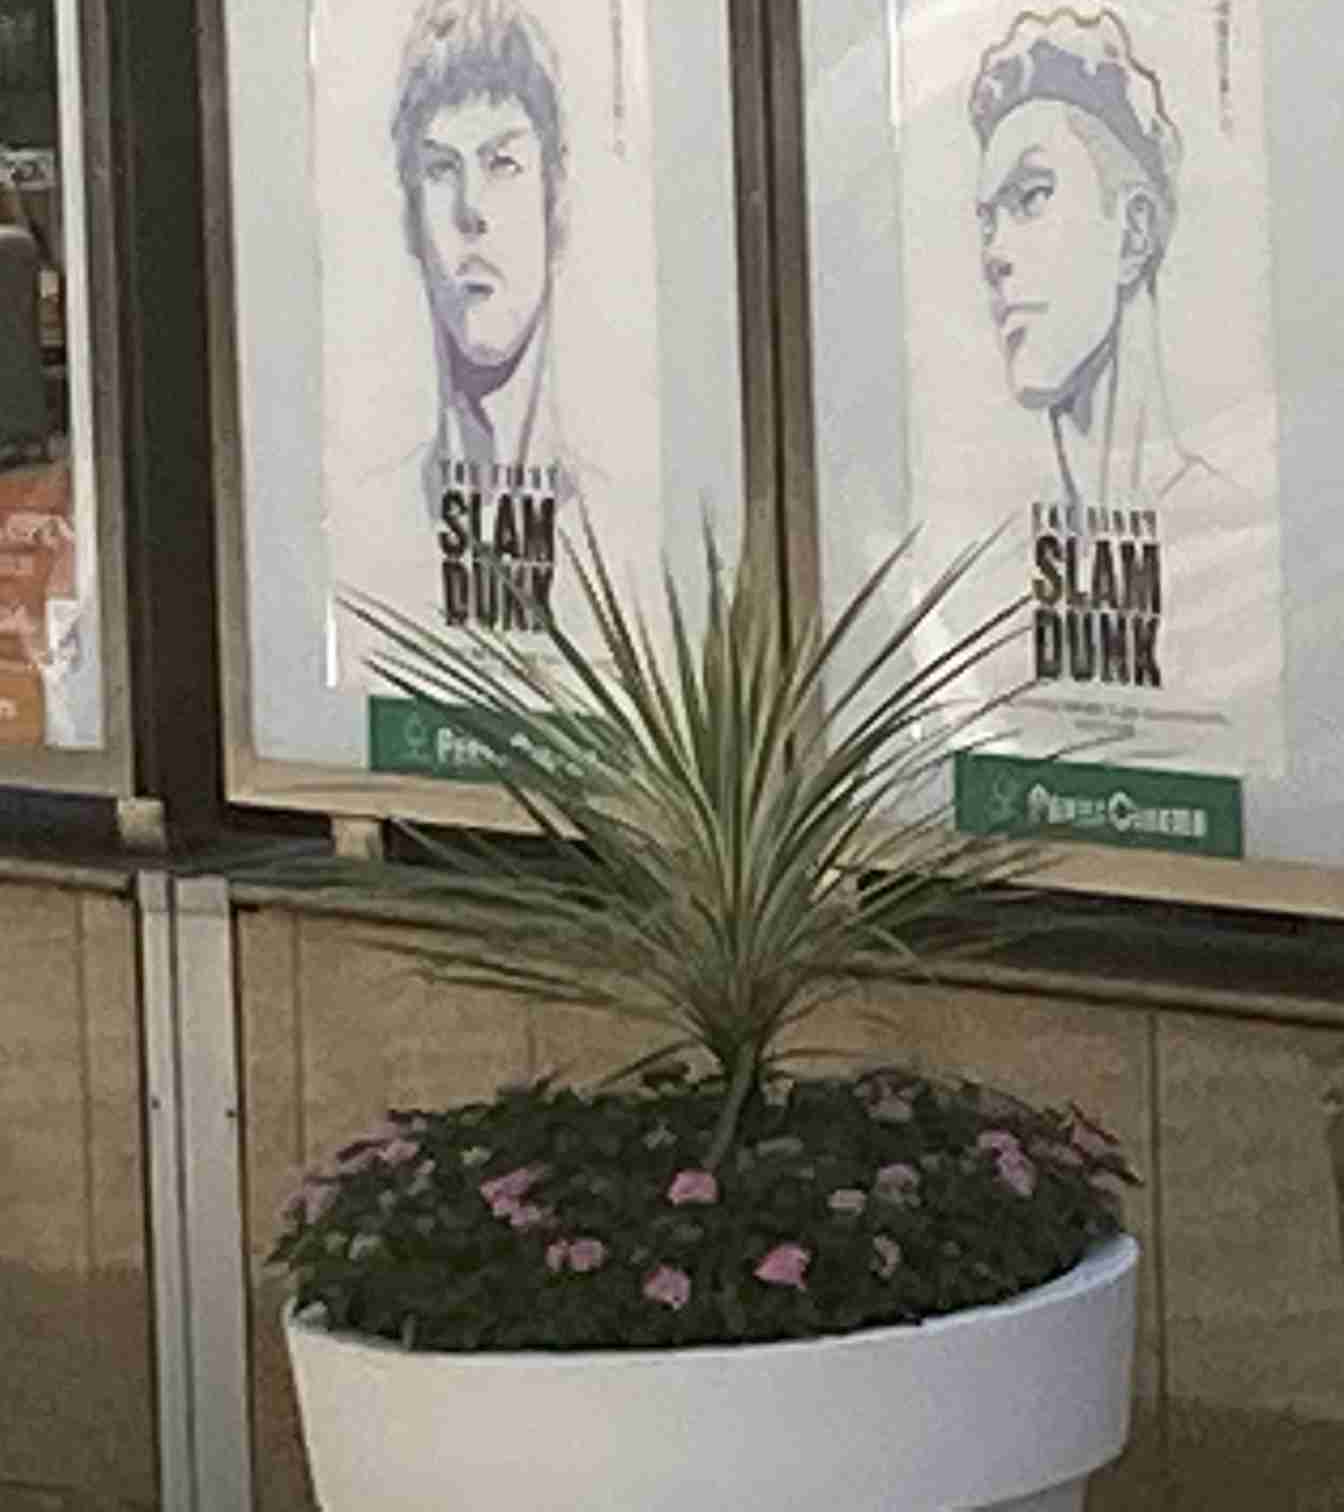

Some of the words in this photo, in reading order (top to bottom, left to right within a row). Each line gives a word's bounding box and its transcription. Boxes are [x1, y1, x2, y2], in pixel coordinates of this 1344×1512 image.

[437, 488, 555, 562] SLAM
[1032, 535, 1163, 615] SLAM
[1034, 608, 1164, 688] DUNK
